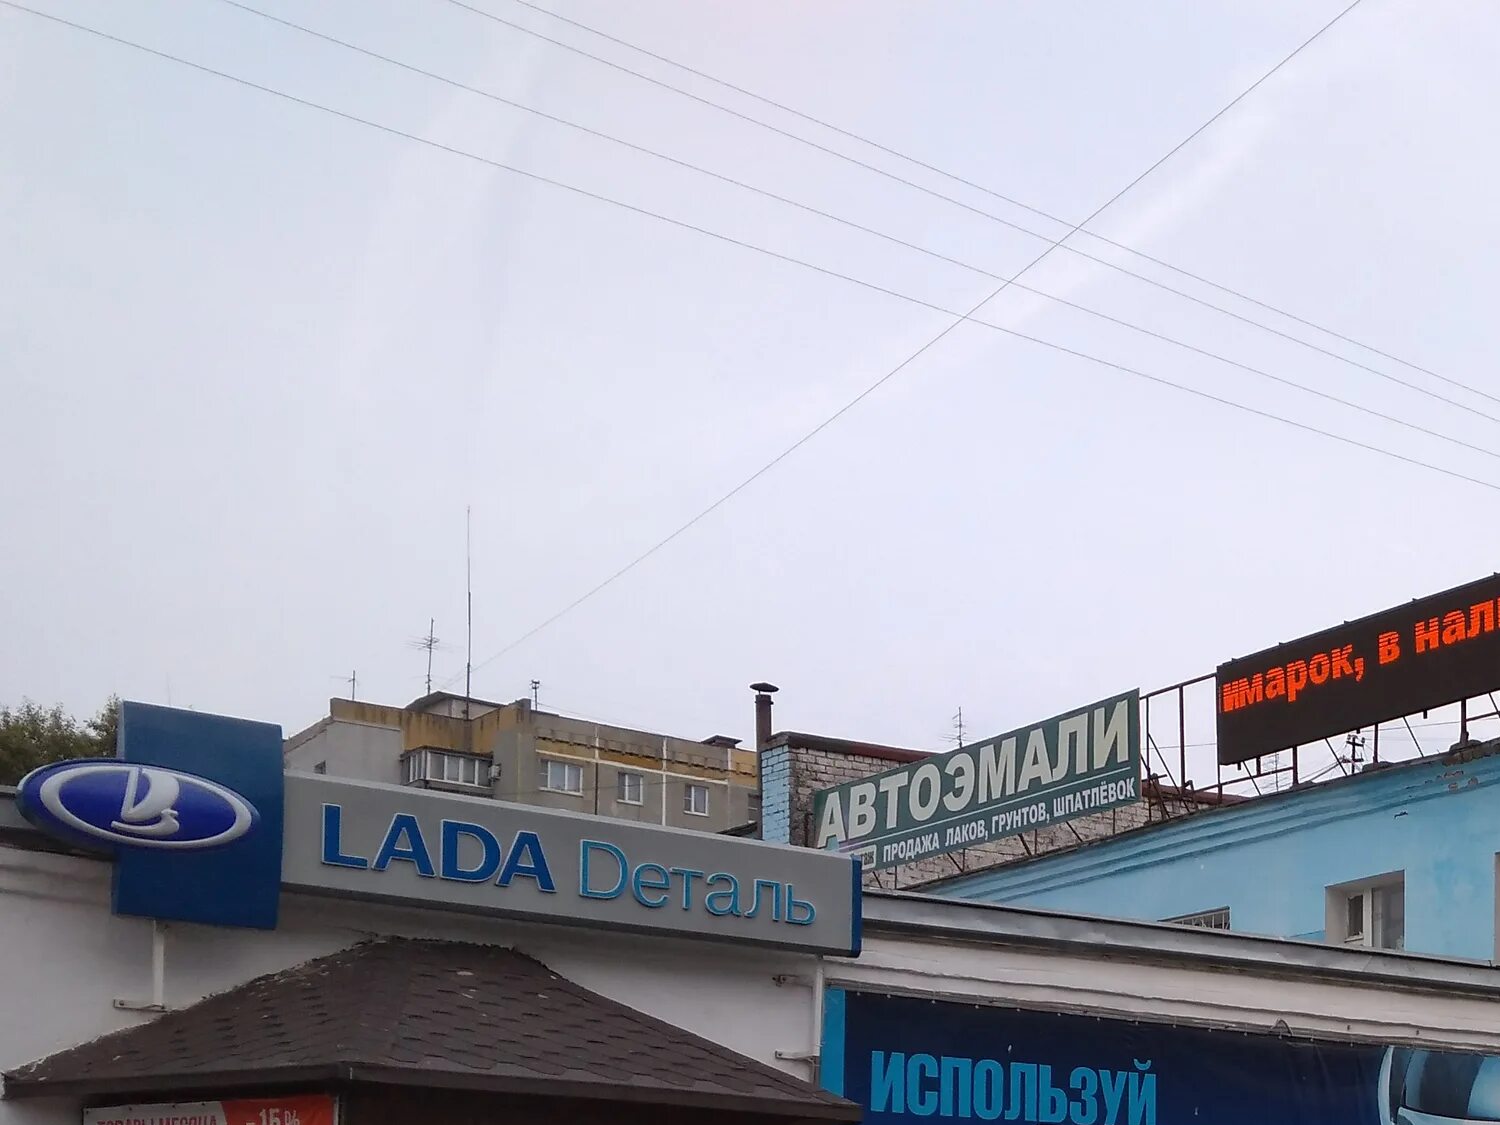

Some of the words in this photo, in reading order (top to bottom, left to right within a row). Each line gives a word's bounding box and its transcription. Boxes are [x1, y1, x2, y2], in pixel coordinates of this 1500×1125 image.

[1377, 630, 1401, 666] в
[816, 699, 1130, 848] АВТОЭМАЛИ
[321, 803, 557, 894] LADA
[883, 828, 940, 863] ПРОДАЖА
[944, 818, 989, 847] ЛАКОВ,
[991, 801, 1050, 836] ГРУНТОВ,
[1053, 777, 1136, 818] ШПАТЛЁВОК
